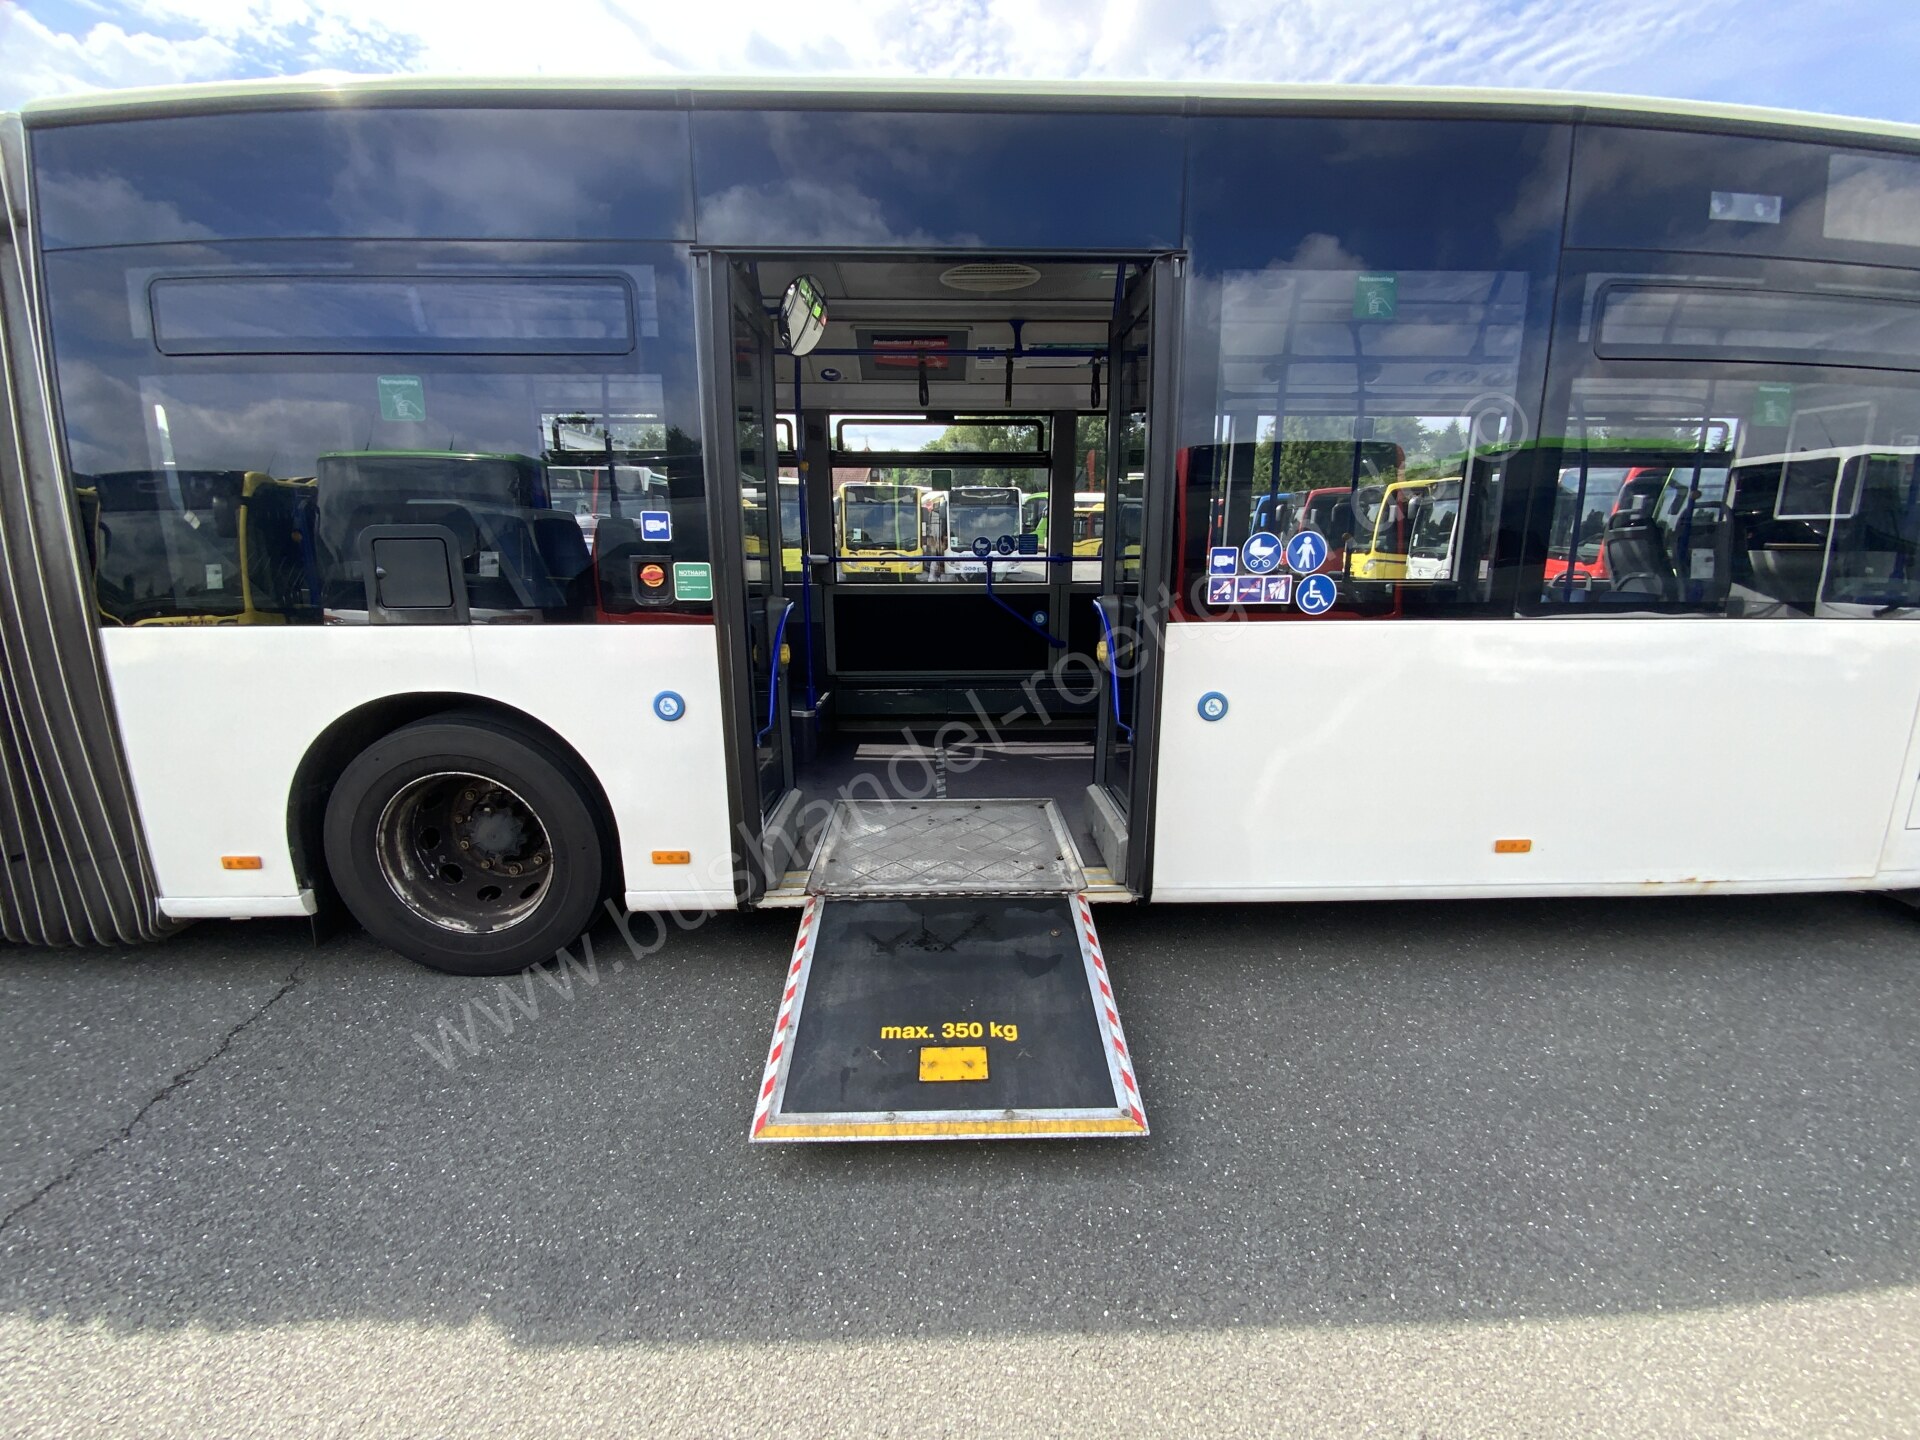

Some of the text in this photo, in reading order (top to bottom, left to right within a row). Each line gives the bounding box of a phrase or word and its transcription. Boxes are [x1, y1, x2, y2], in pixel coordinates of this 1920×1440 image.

[678, 569, 708, 577] NOTHAHN
[880, 1021, 1018, 1042] max. 350 kg
